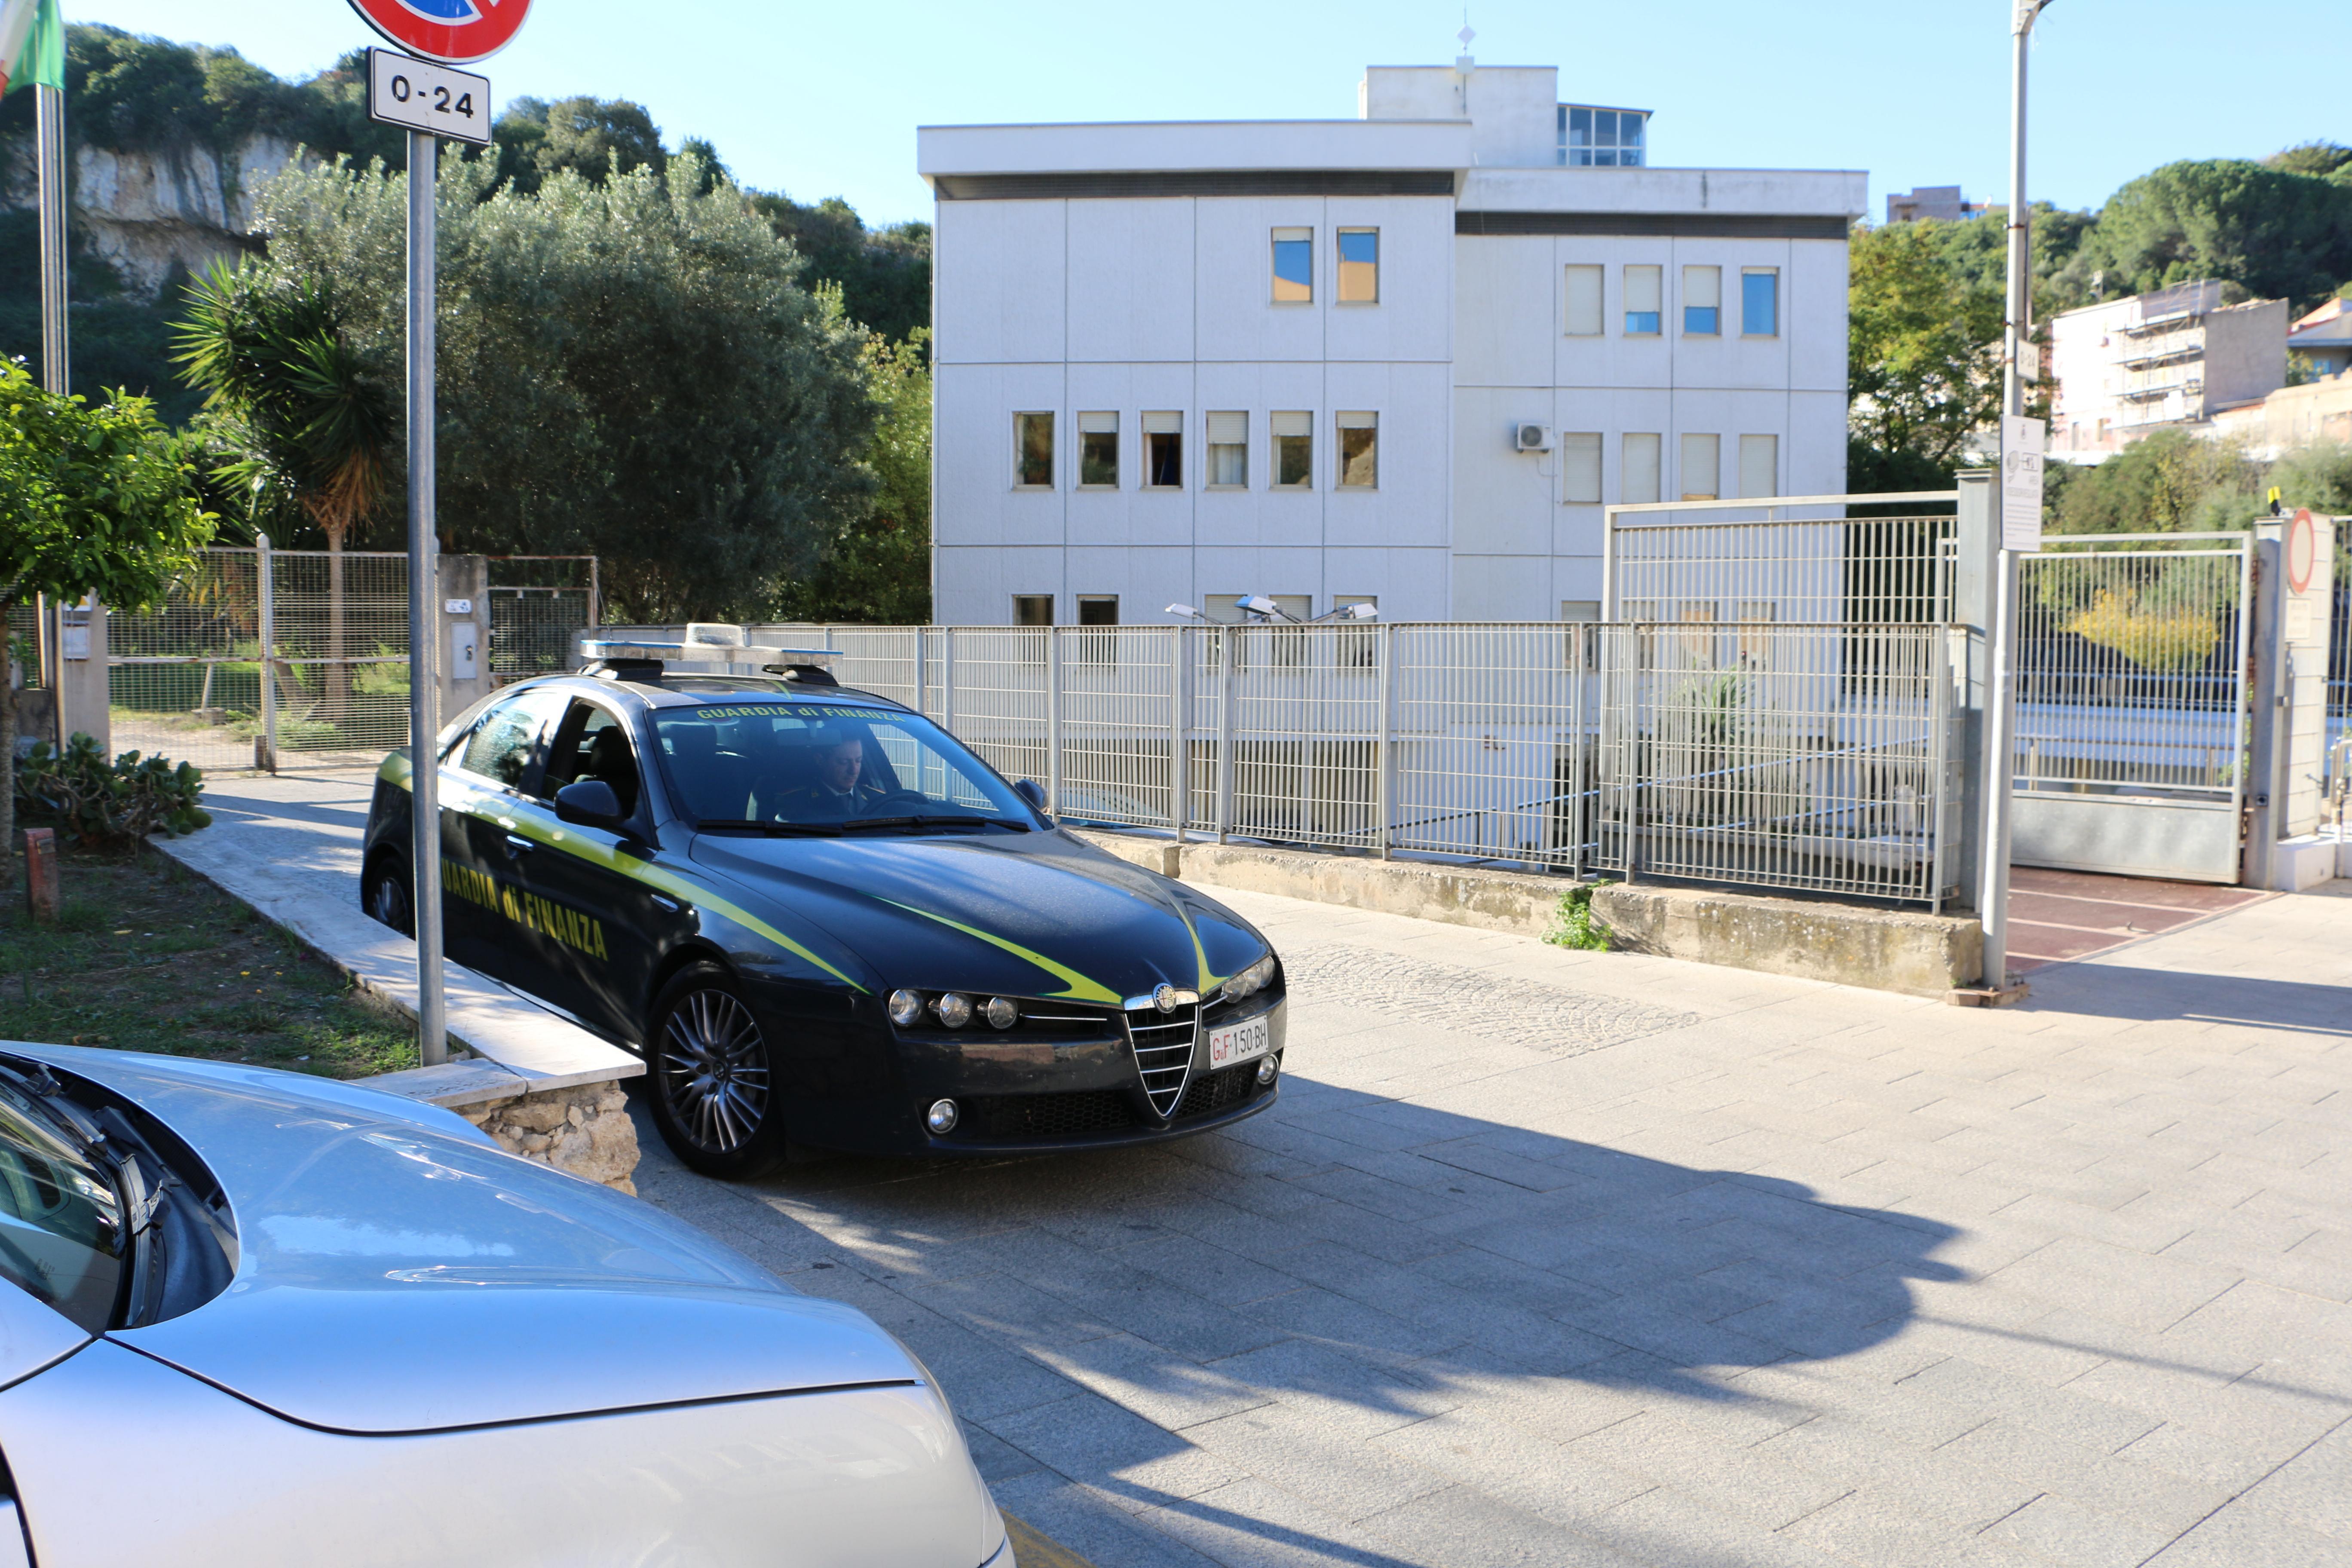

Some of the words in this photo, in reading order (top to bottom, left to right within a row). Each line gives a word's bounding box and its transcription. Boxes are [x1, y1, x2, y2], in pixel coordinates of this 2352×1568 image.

[697, 707, 793, 719] GUARDIA
[798, 707, 820, 716] di
[821, 708, 906, 723] FINANZA
[441, 857, 500, 913] UARDIA
[502, 884, 521, 923] di
[523, 891, 609, 962] FINANZA
